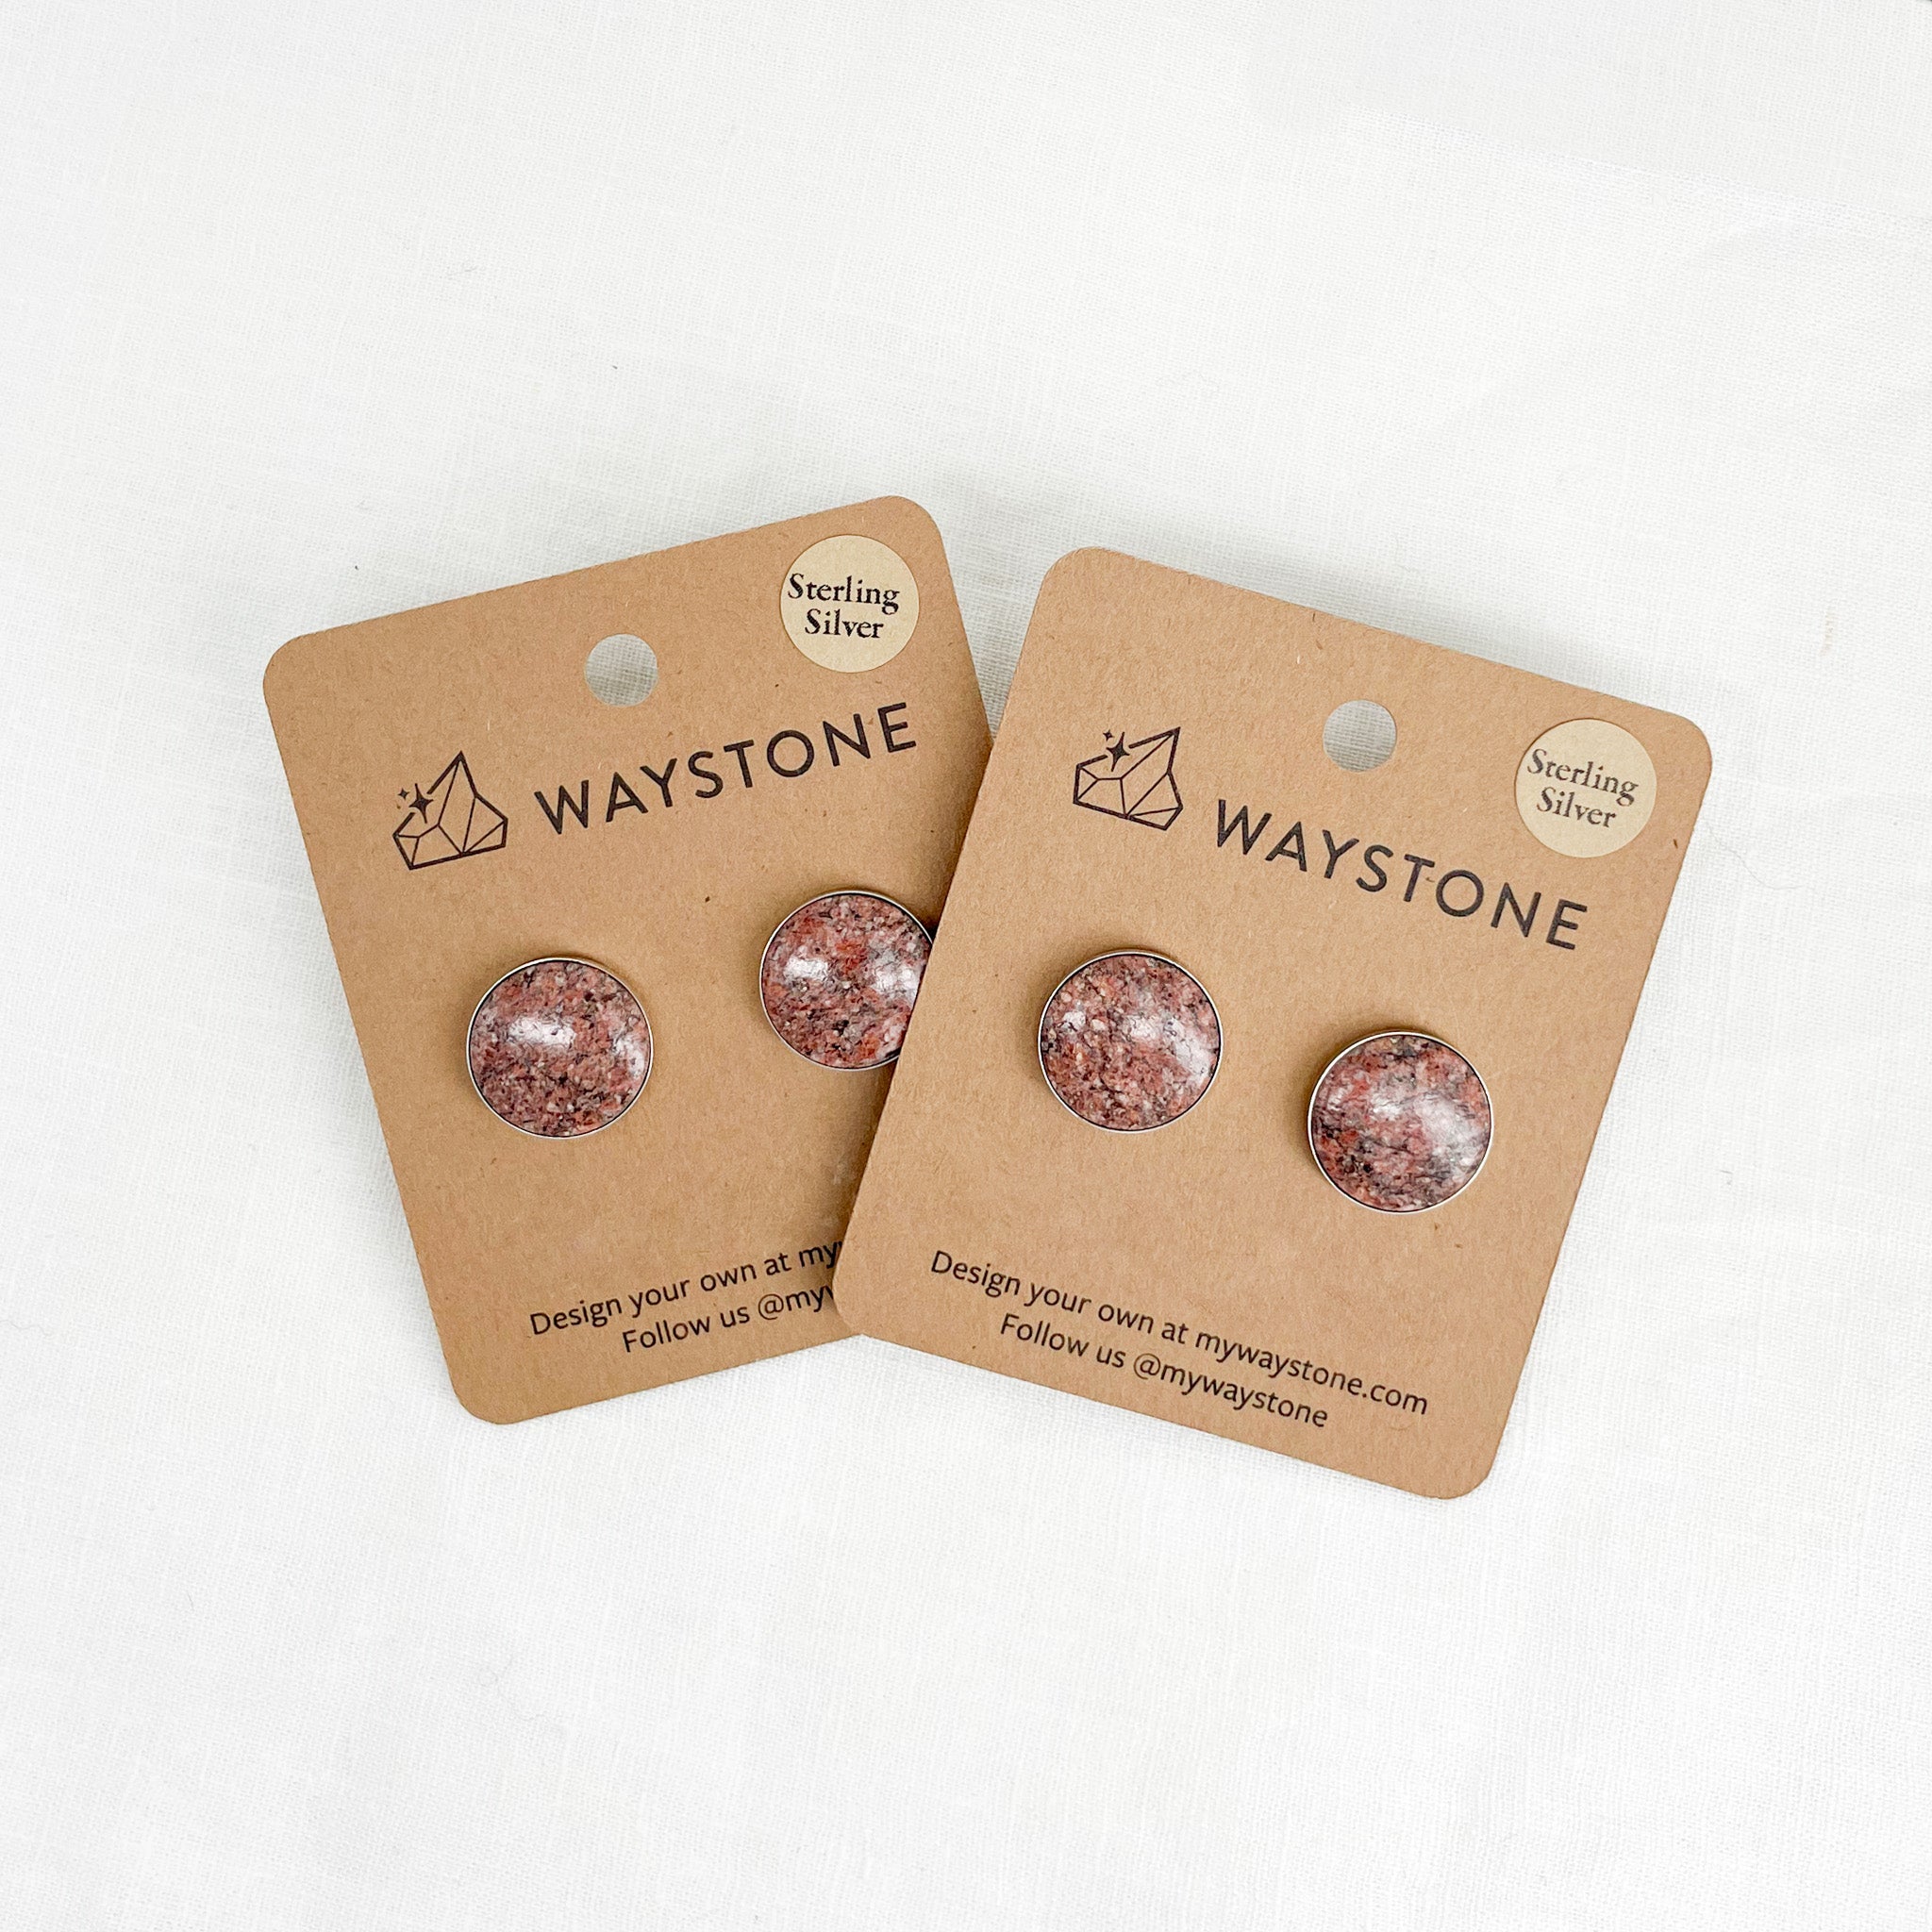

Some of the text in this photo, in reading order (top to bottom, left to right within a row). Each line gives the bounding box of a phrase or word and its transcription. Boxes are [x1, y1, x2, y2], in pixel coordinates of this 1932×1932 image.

[787, 573, 901, 615] Sterling
[804, 608, 885, 640] Silver
[533, 702, 918, 836] WAYSTONE
[1526, 748, 1640, 807] Sterling
[1537, 787, 1617, 828] Silver
[1216, 798, 1589, 952] WAYSTONE
[529, 1241, 842, 1336] Design your own at my
[622, 1284, 834, 1353] Follow us @my
[930, 1250, 1428, 1415] Design your own at mywaystone.com
[1000, 1312, 1329, 1429] Follow us @mywaystone
